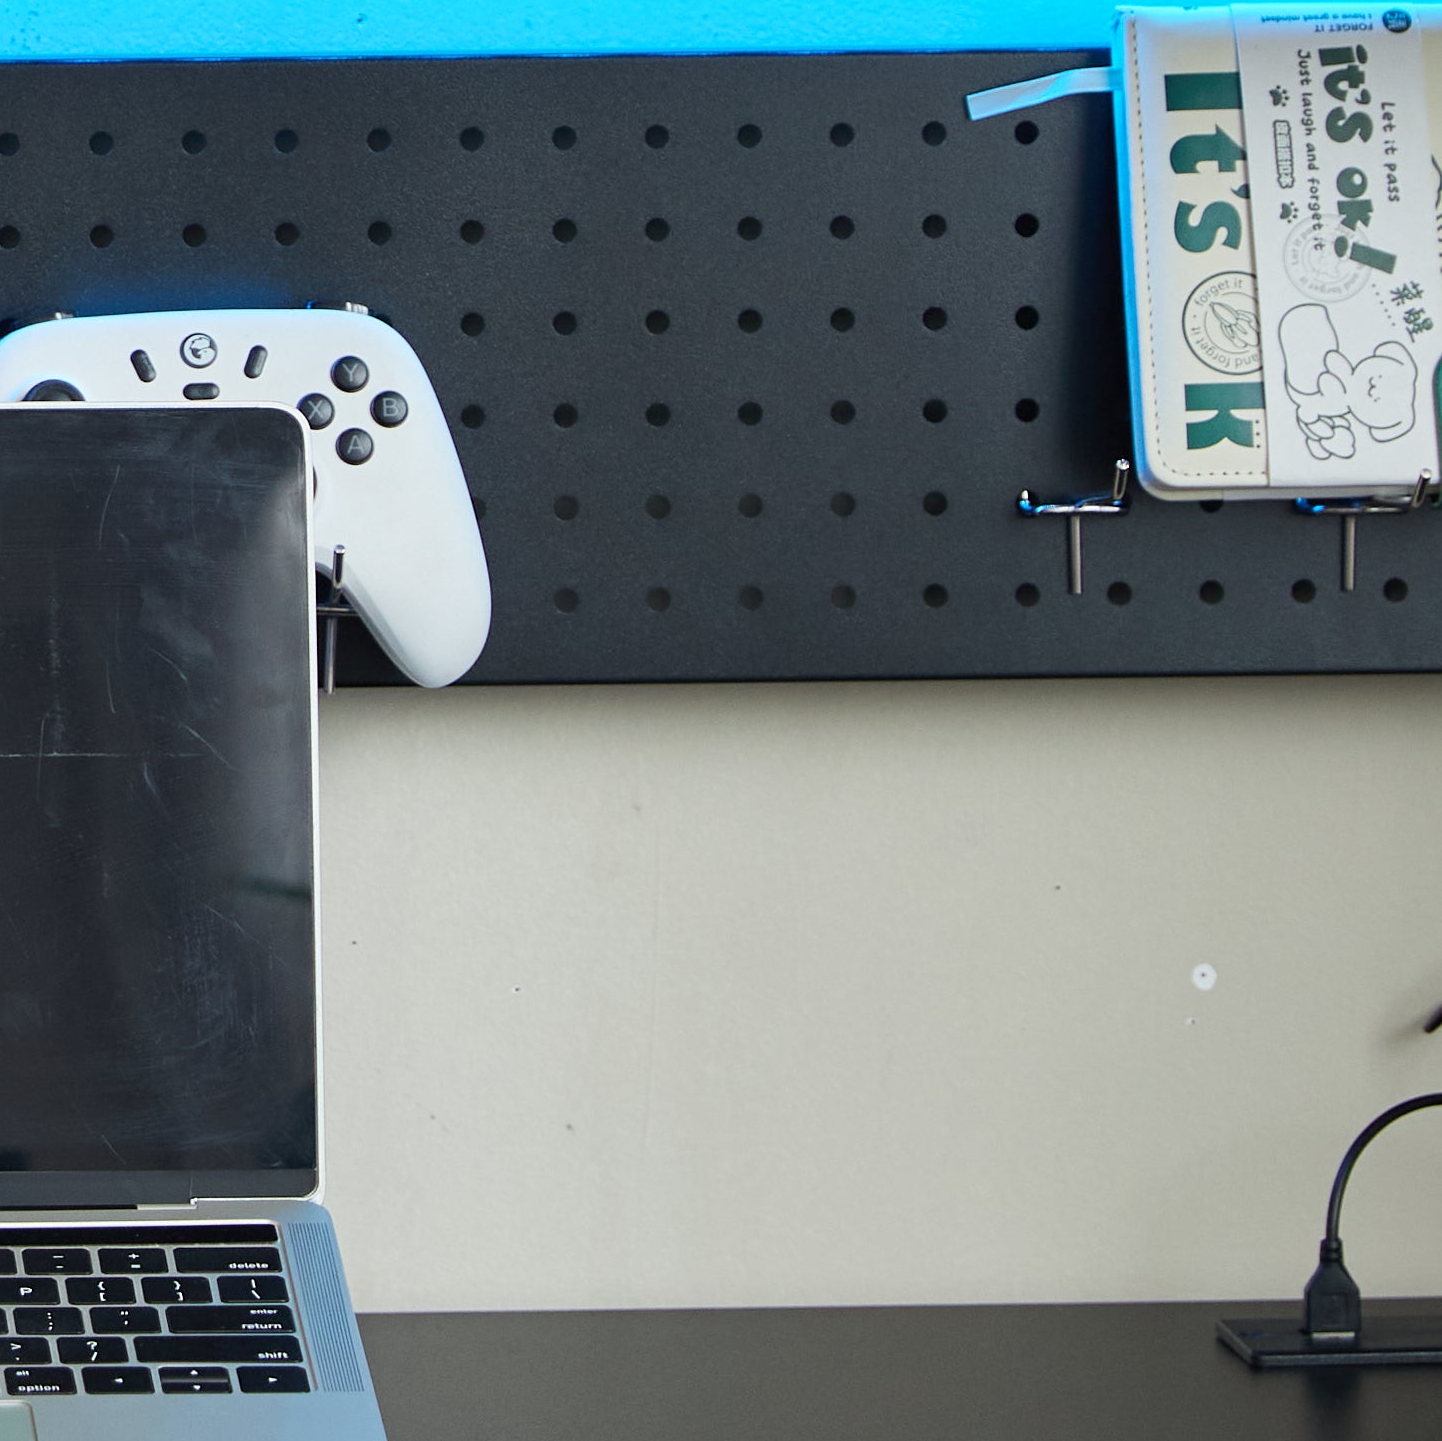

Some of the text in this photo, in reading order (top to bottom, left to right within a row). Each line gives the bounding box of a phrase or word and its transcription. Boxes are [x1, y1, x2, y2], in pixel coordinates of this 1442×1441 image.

[1328, 23, 1373, 32] FORGET
[1297, 48, 1326, 251] Just laugh and forget it
[1381, 101, 1402, 203] Let it pass
[1334, 168, 1397, 274] ok!
[1194, 278, 1243, 307] forget it
[342, 364, 357, 383] Y
[306, 398, 399, 418] X B
[346, 435, 365, 454] A
[20, 1287, 33, 1296] P
[258, 1351, 288, 1360] shift
